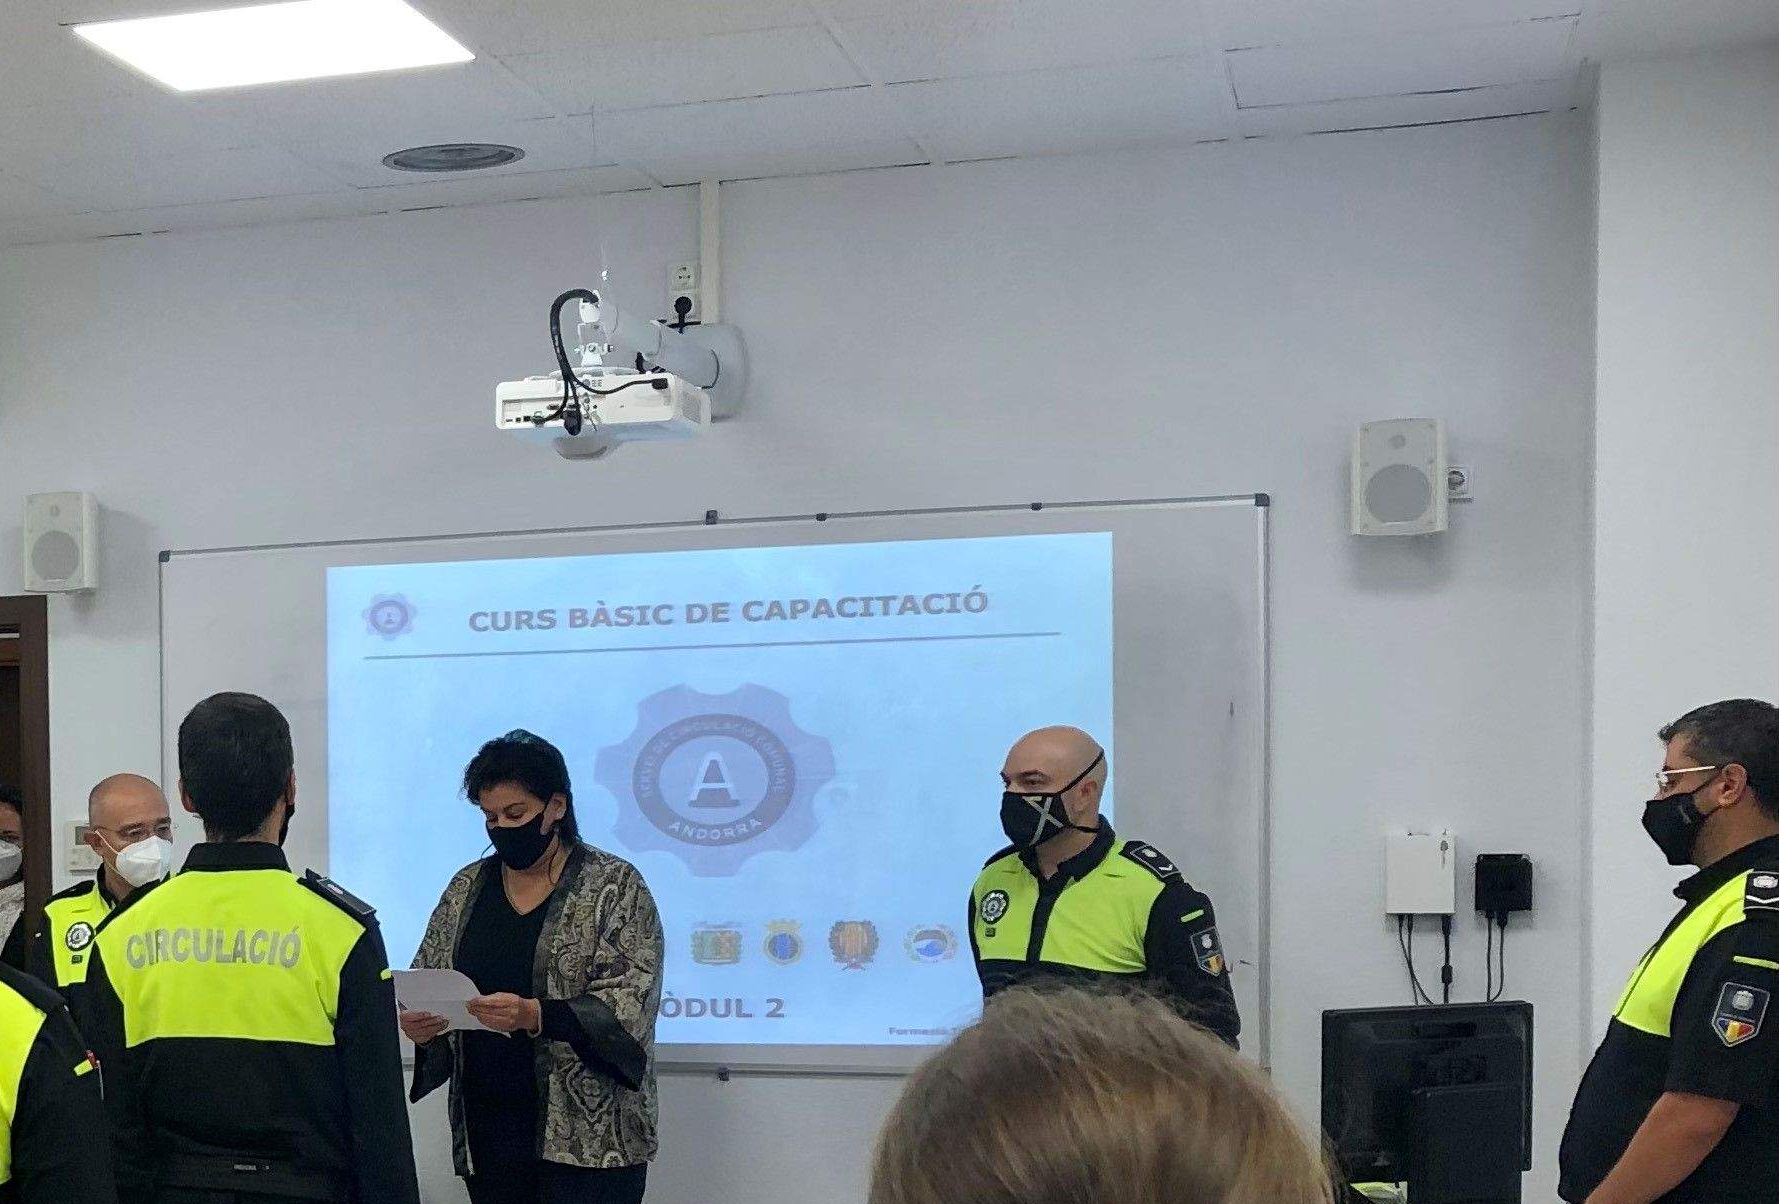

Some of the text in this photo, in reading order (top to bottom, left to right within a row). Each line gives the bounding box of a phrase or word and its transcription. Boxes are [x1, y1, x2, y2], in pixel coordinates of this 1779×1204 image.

[469, 584, 988, 632] CURS BÀSIC DE CAPACITACIÓ
[669, 818, 762, 840] ANDORRA
[127, 926, 302, 969] CIRCULACIÓ
[661, 990, 785, 1018] ÒDUL 2
